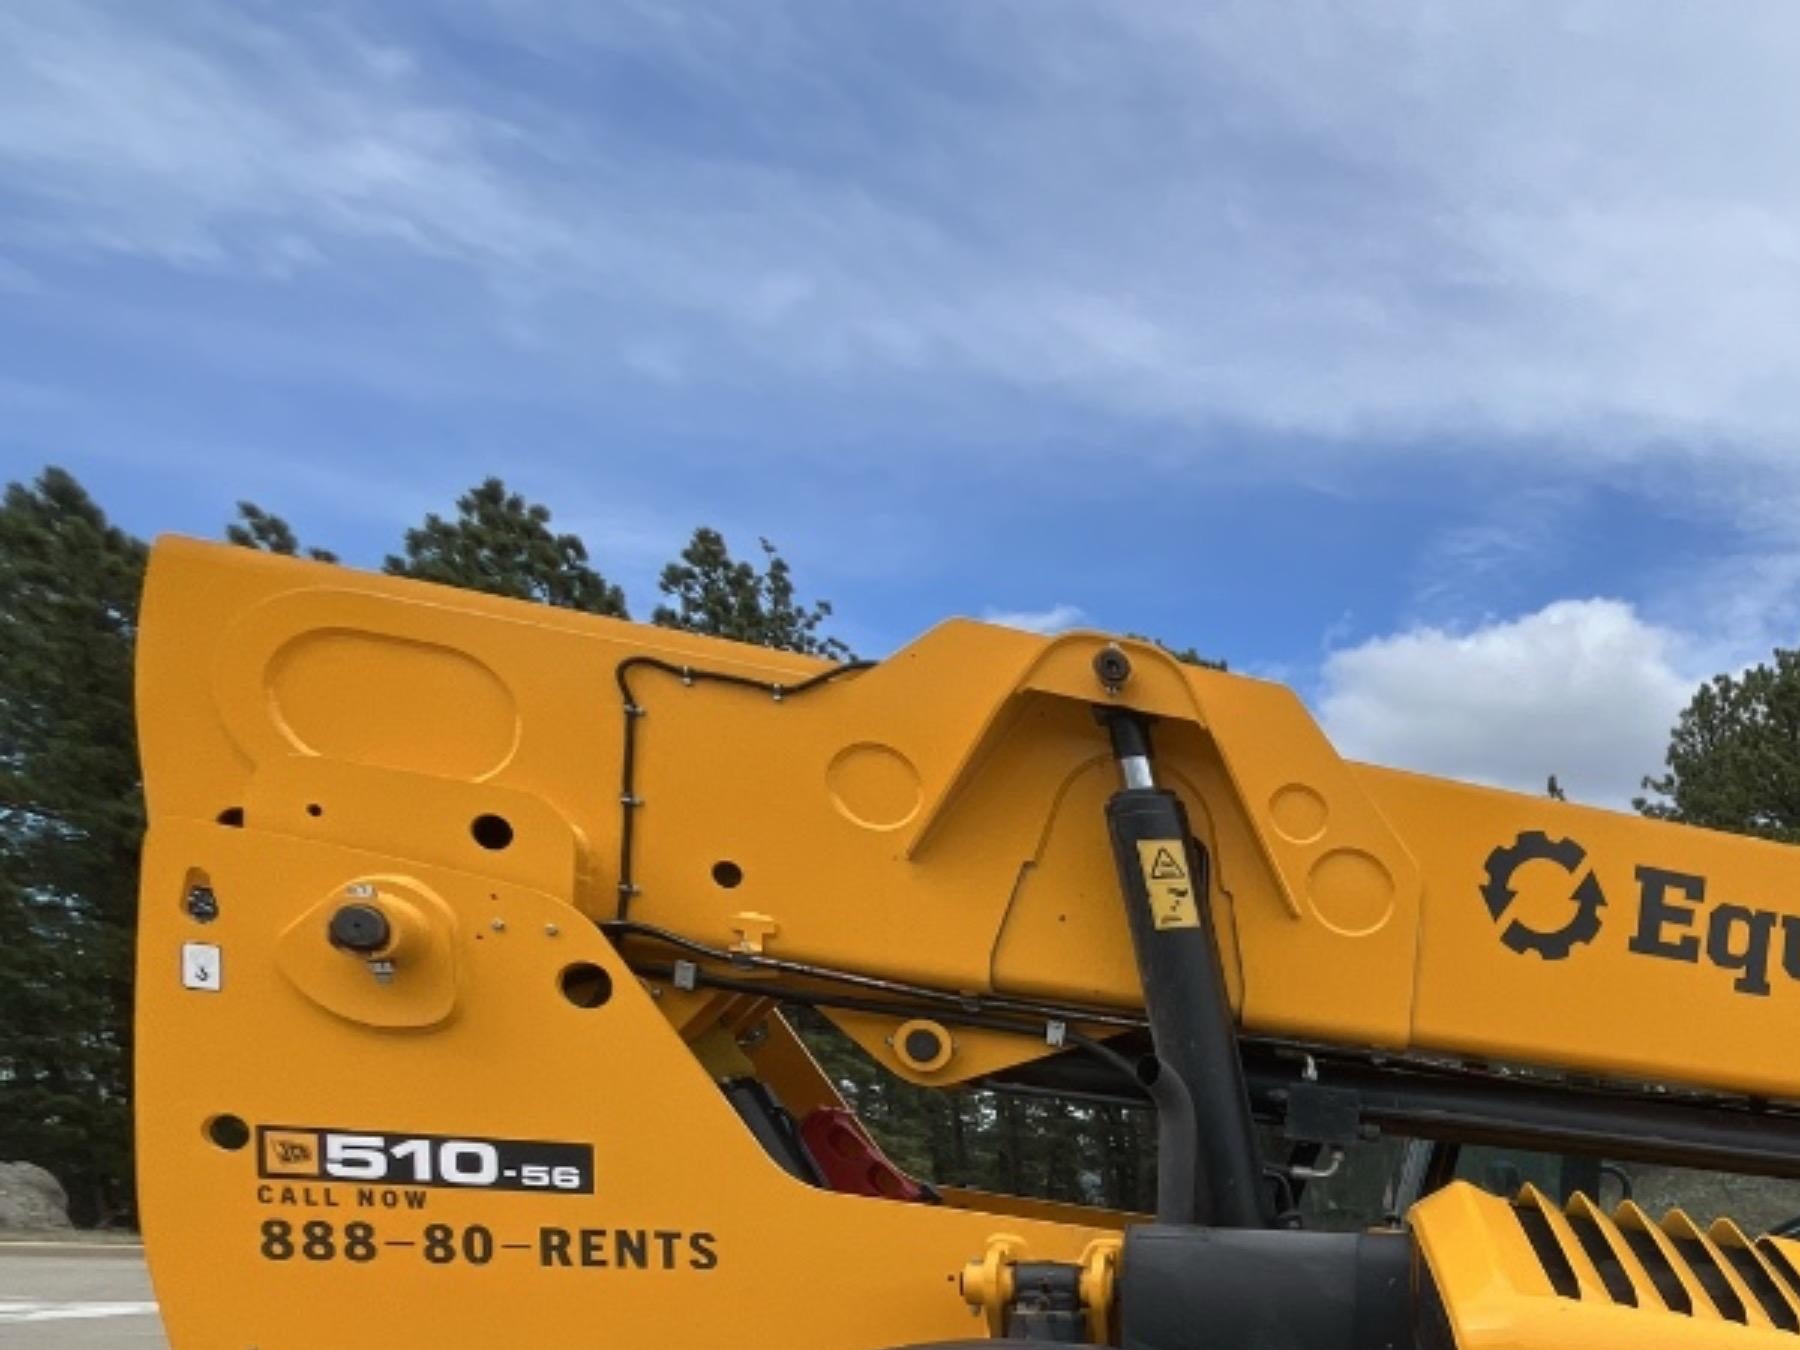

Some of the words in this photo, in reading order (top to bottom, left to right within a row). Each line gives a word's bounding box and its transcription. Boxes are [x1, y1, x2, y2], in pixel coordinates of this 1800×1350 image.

[324, 1133, 581, 1189] 510-56
[257, 1185, 340, 1207] CALL
[358, 1188, 428, 1209] NOW
[260, 1218, 720, 1271] 888-80-RENTS
